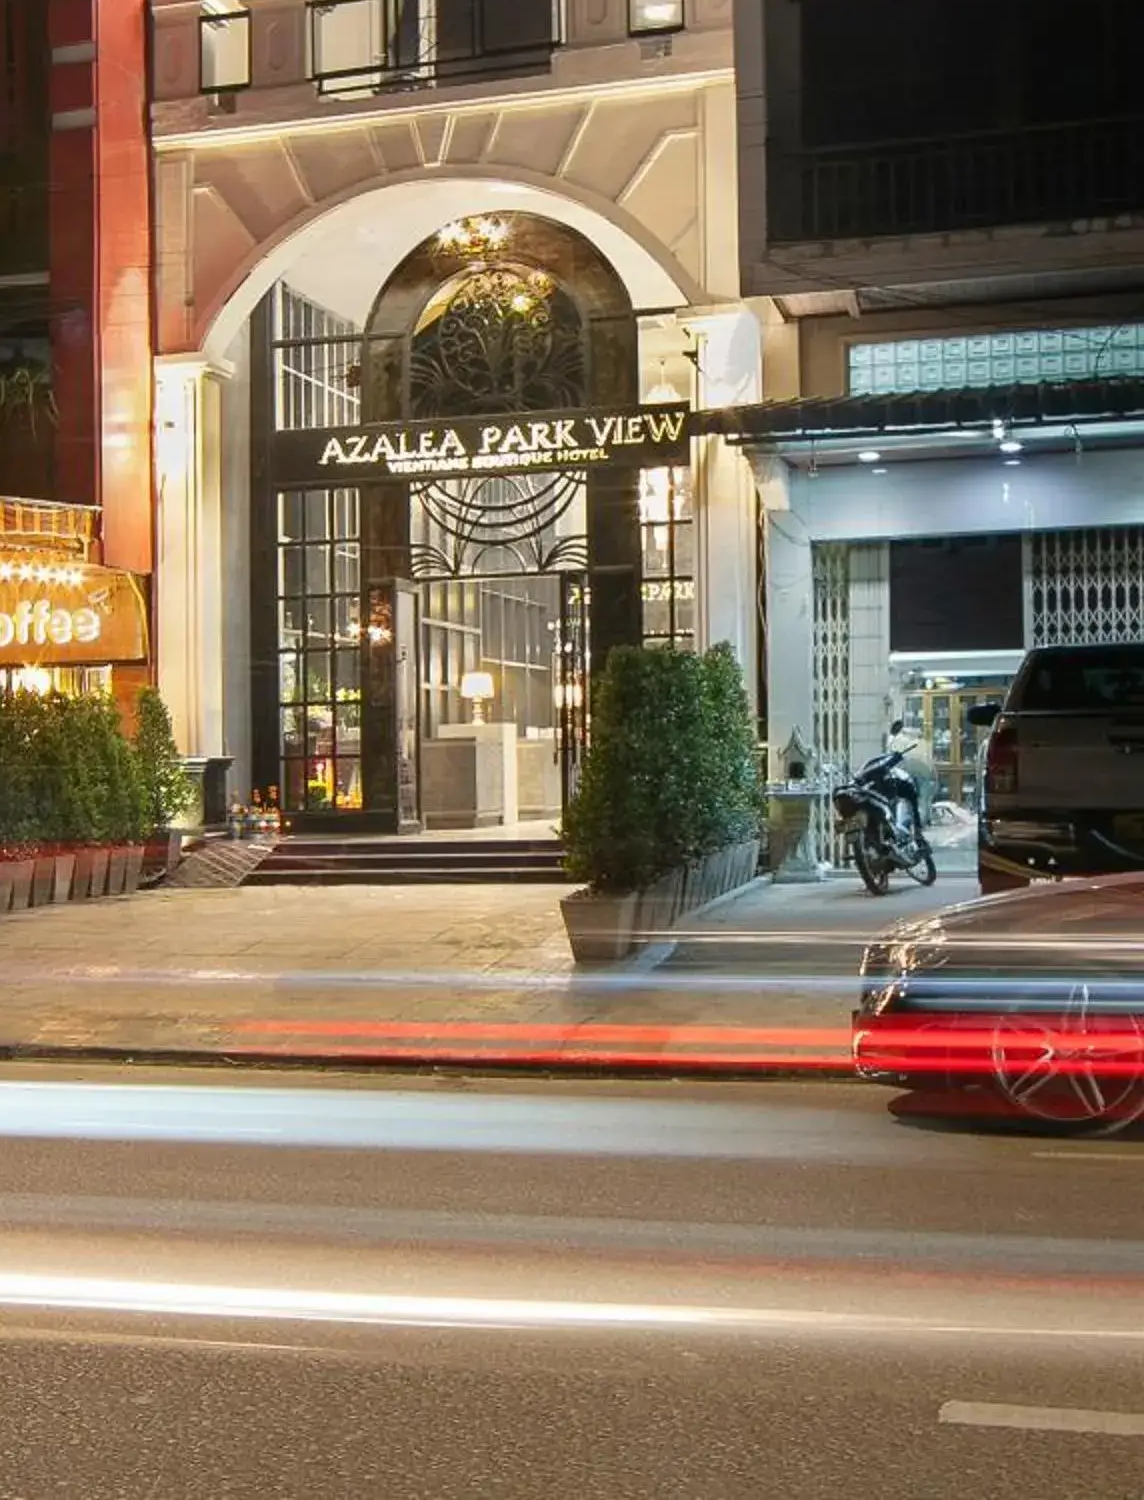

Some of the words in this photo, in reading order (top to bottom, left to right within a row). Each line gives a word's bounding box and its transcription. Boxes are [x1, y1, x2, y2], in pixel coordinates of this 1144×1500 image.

[317, 429, 467, 466] AZALEA
[478, 419, 578, 454] PARK
[584, 411, 686, 447] VIEW
[471, 452, 555, 470] BOUTIQUE
[557, 446, 610, 461] HOTEL
